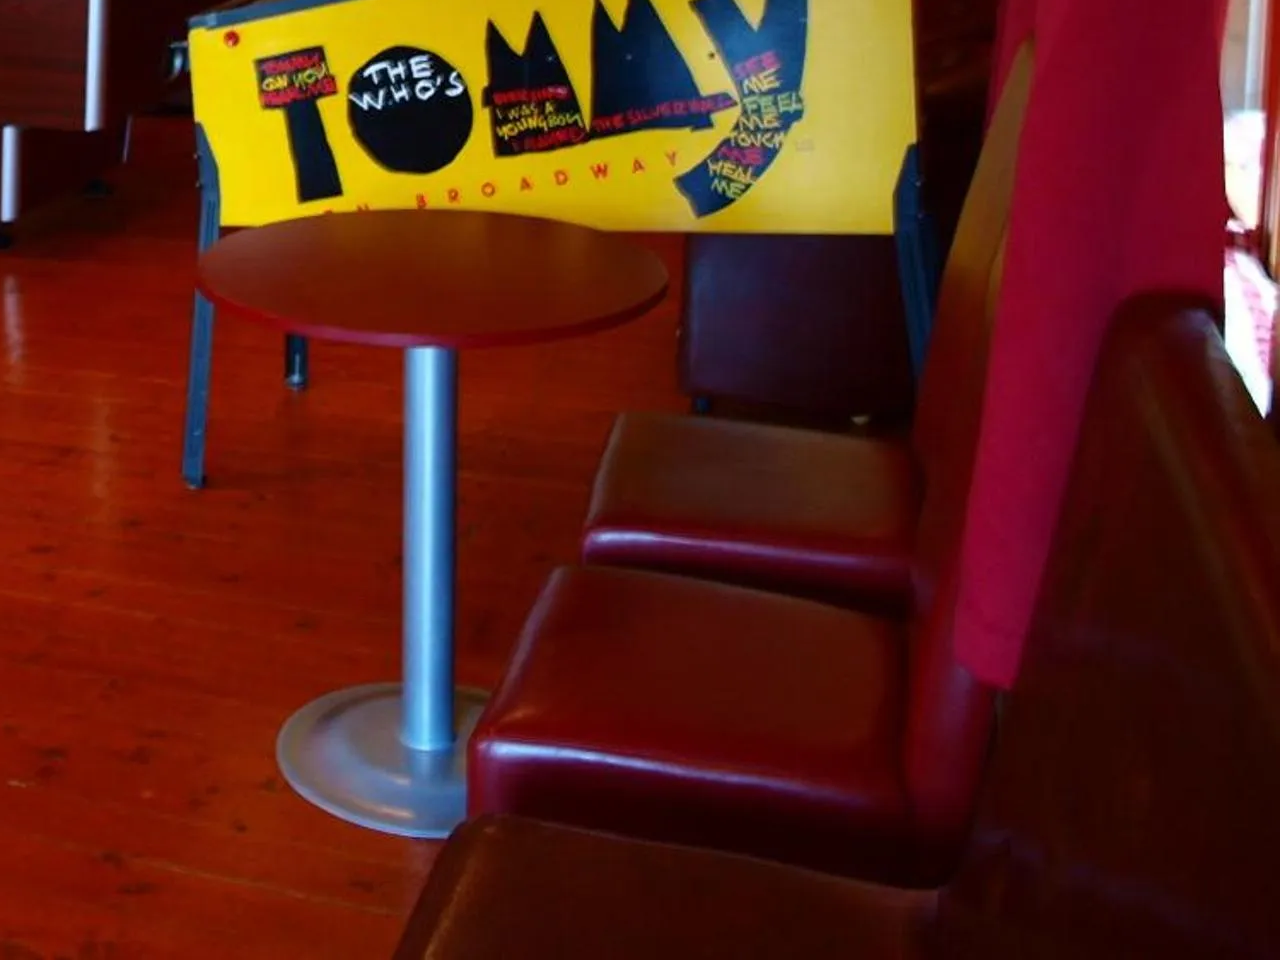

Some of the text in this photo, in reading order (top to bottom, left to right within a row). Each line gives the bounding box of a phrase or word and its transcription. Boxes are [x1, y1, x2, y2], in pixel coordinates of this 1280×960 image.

[363, 53, 433, 86] THE
[742, 67, 782, 94] ME
[348, 71, 466, 112] WHO'S
[742, 91, 803, 117] FEEL
[738, 113, 782, 132] ME
[729, 130, 786, 148] TOUCH
[415, 151, 679, 210] BROADWAY
[706, 158, 757, 184] HEAL
[710, 176, 748, 200] ME
